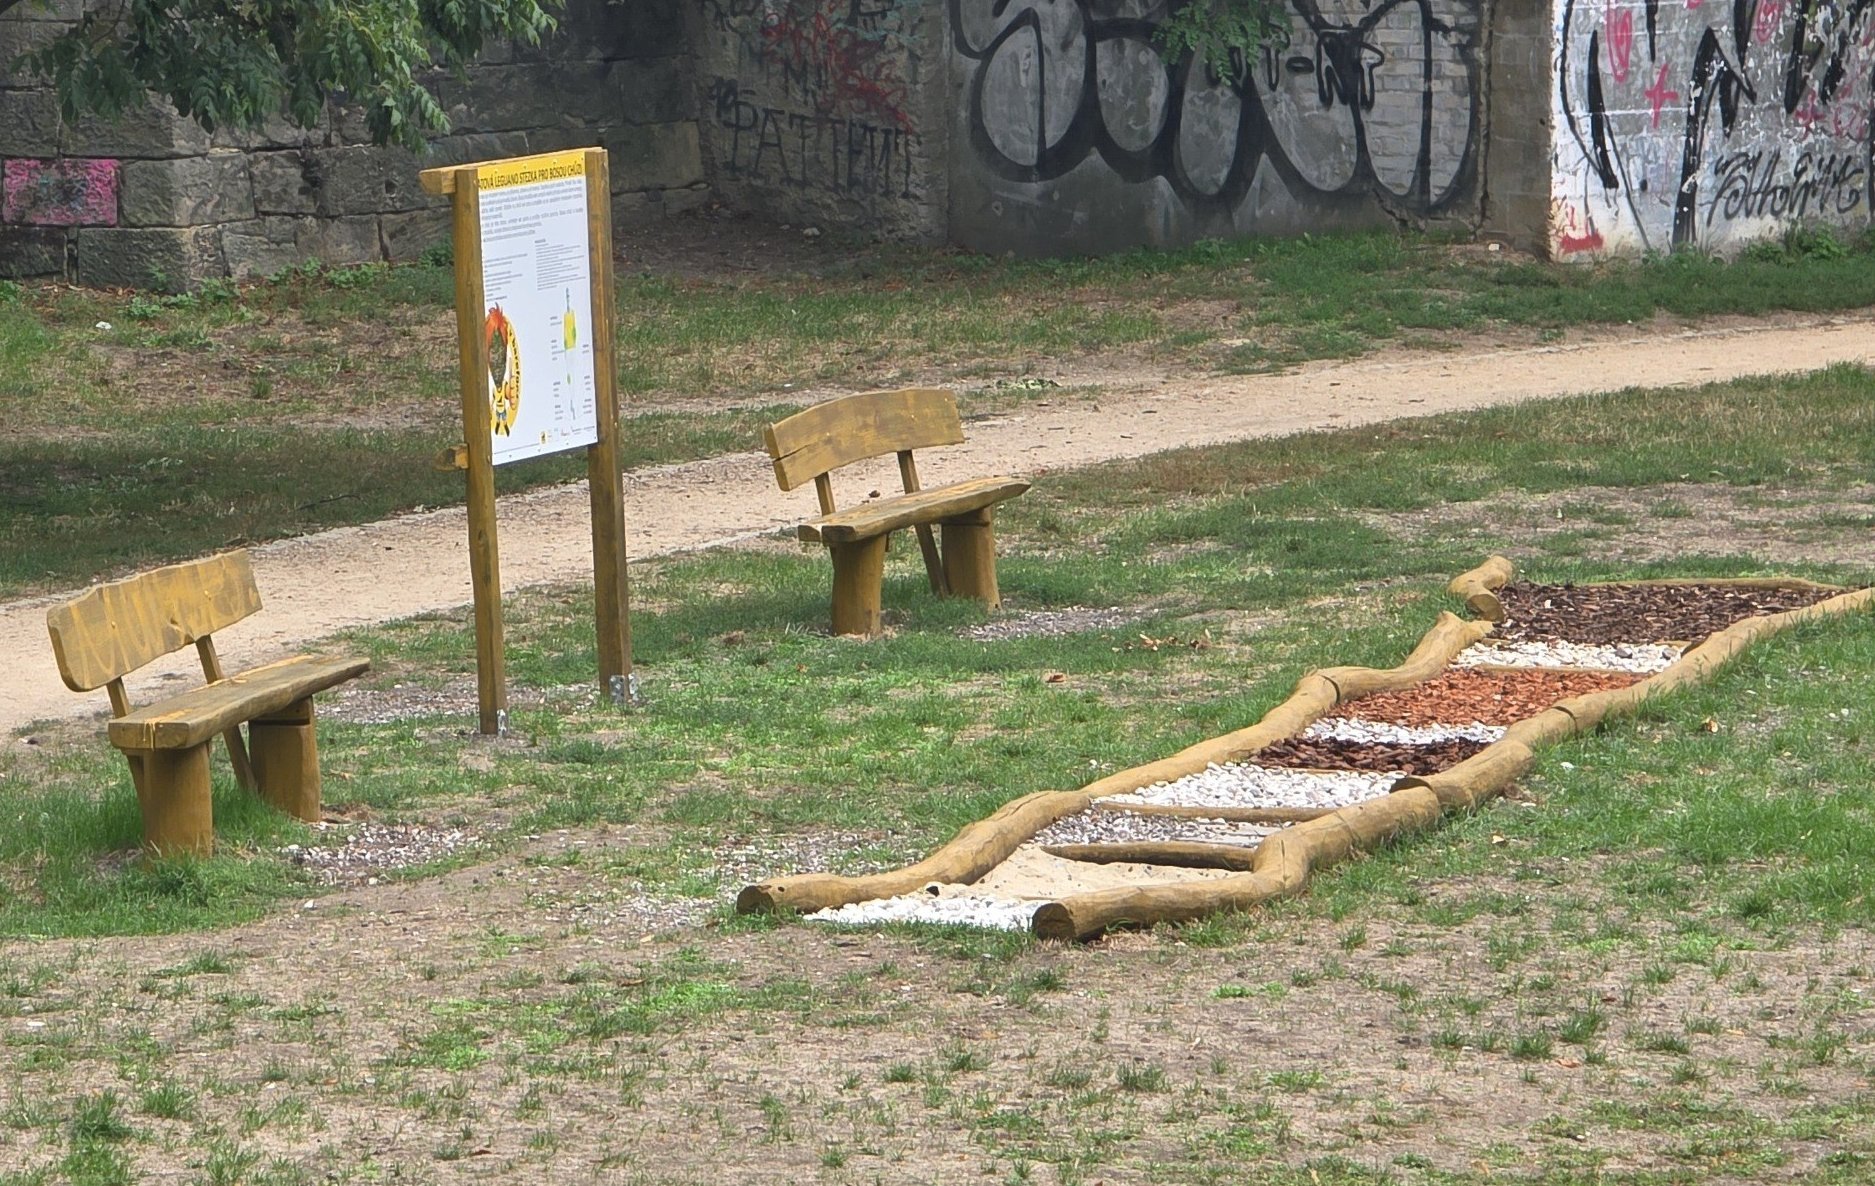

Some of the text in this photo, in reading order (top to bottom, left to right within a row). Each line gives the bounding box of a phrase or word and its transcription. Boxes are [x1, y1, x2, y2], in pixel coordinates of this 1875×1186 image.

[495, 173, 518, 187] LEGUANO
[520, 171, 537, 183] STEZKA
[538, 169, 548, 181] PRO
[549, 166, 566, 179] BOSOU
